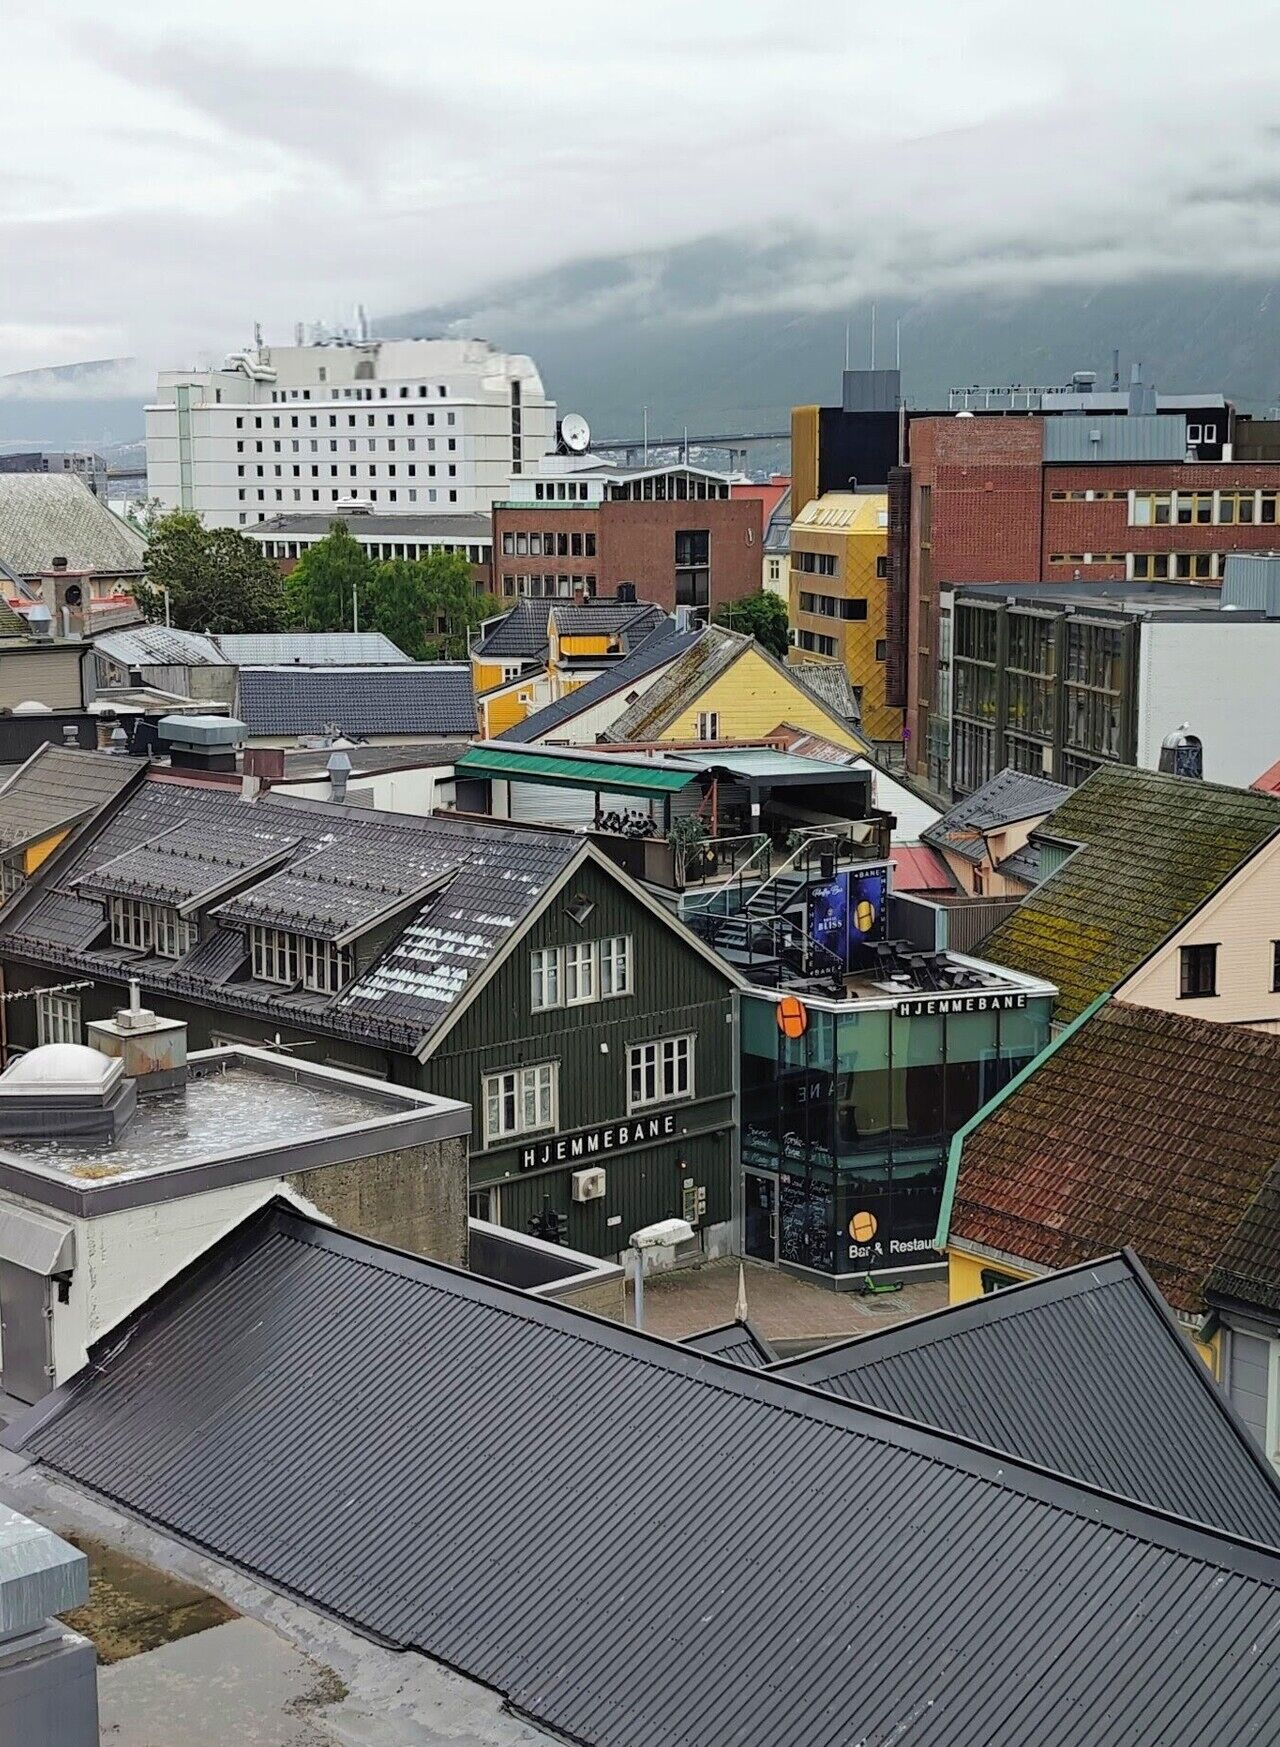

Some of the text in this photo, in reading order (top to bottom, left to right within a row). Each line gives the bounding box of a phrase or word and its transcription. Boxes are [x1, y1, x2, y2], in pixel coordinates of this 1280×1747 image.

[900, 995, 1025, 1016] HJEMMEBANE
[524, 1116, 674, 1168] HJEMMEBANE
[849, 1245, 870, 1259] Bar
[874, 1242, 884, 1256] &
